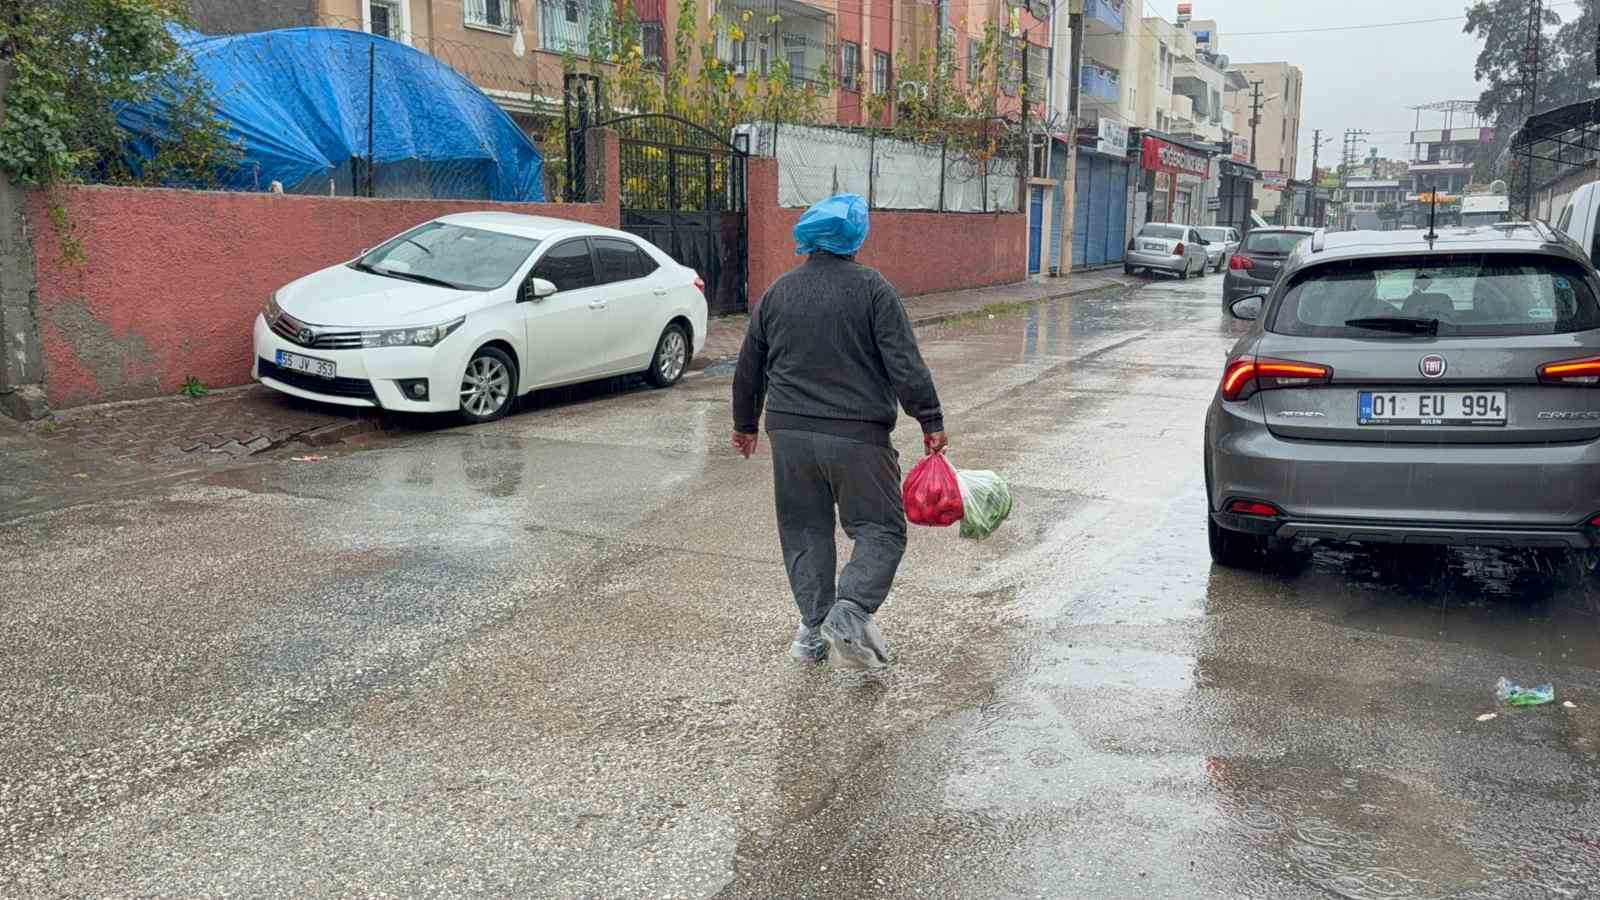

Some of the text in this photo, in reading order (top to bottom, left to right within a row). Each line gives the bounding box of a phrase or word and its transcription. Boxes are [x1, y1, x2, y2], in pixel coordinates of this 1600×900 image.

[299, 357, 310, 370] JV
[316, 361, 334, 377] 353
[1425, 360, 1441, 373] FIAT
[1373, 395, 1502, 416] 01 EU 994
